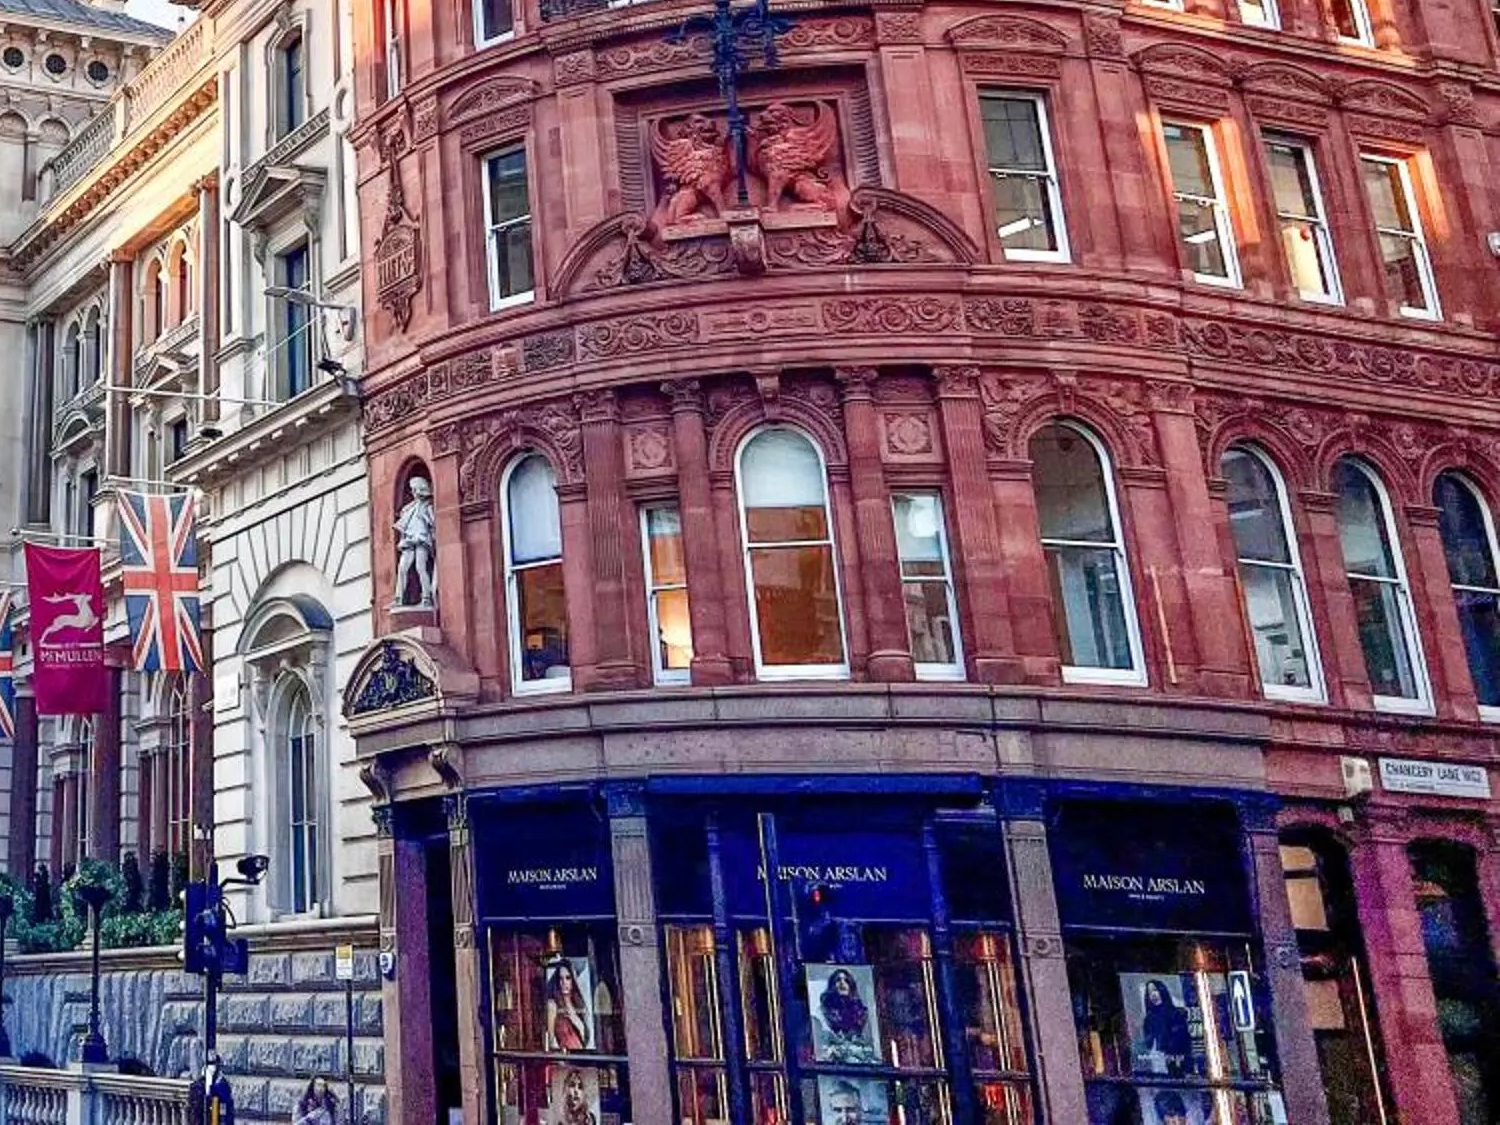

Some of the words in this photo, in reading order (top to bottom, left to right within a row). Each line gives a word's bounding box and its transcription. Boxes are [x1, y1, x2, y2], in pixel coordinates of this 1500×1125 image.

[508, 868, 551, 883] MAISON
[553, 866, 597, 882] ARSLAN
[823, 866, 887, 882] ARSLAN
[1083, 874, 1143, 892] MAISON
[1147, 877, 1205, 894] ARSLAN
